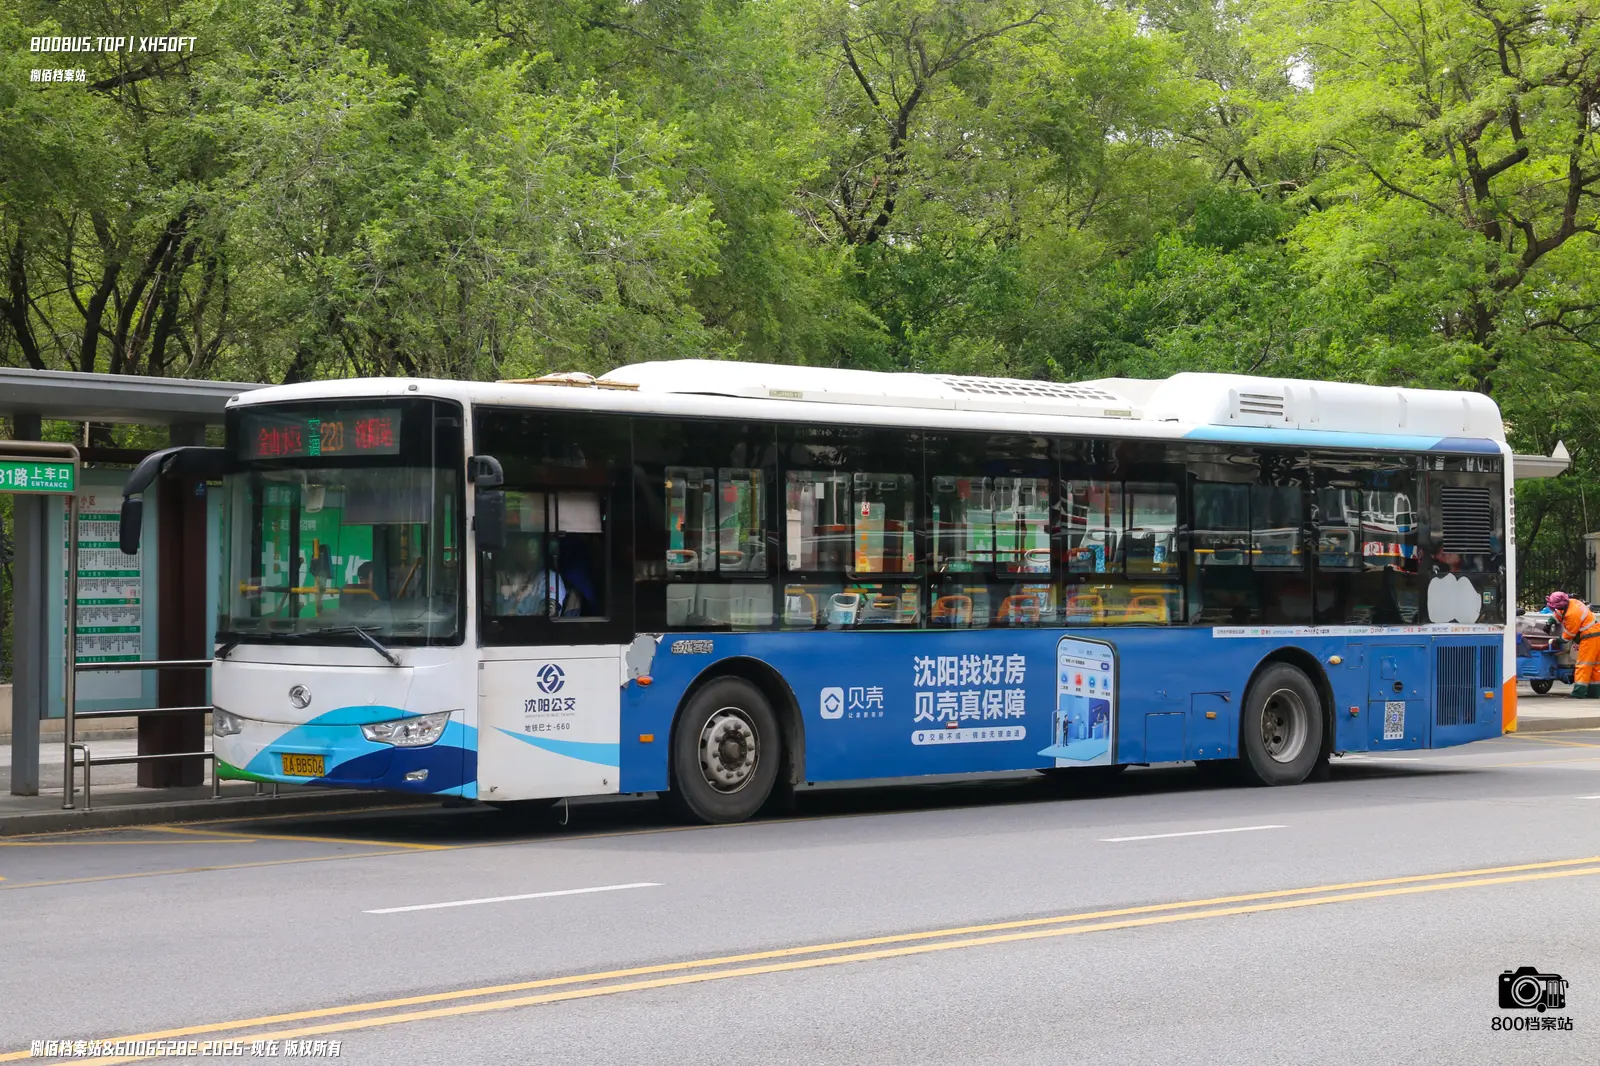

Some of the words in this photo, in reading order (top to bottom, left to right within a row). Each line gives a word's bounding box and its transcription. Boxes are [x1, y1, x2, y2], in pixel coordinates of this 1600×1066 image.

[30, 466, 70, 480] 上车口
[31, 480, 68, 488] ENTRANCE
[913, 653, 1026, 687] 沈阳找好房
[524, 697, 576, 713] 沈阳公交
[848, 685, 884, 710] 贝壳
[913, 688, 1026, 723] 贝壳真保障
[524, 722, 571, 733] 地铁巴士-660
